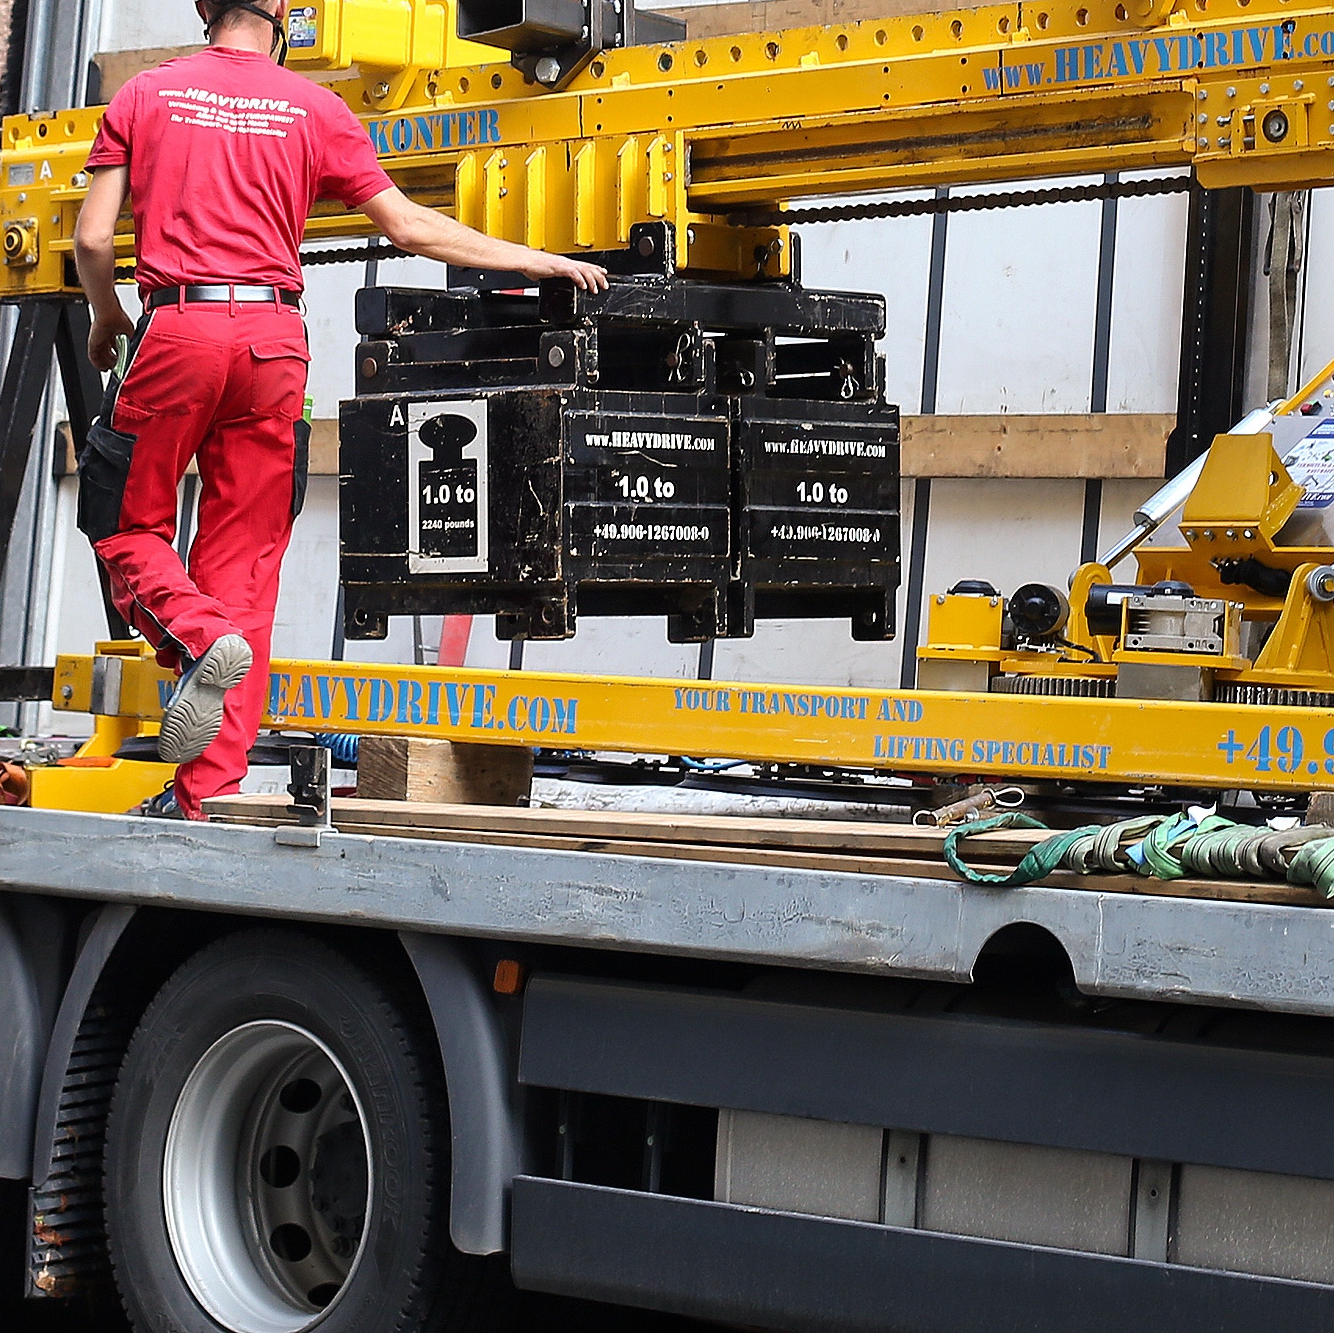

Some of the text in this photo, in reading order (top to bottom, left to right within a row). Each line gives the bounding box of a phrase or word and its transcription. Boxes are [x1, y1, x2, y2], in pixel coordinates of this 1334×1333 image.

[39, 160, 53, 180] A
[389, 405, 405, 427] A
[422, 484, 475, 505] 1.0 to
[618, 475, 675, 498] 1.0 to
[796, 481, 849, 504] 1.0 to
[422, 517, 475, 531] 2240 pounds
[673, 687, 924, 725] YOUR TRANSPORT AND
[873, 735, 1112, 771] LIFTING SPECIALIST
